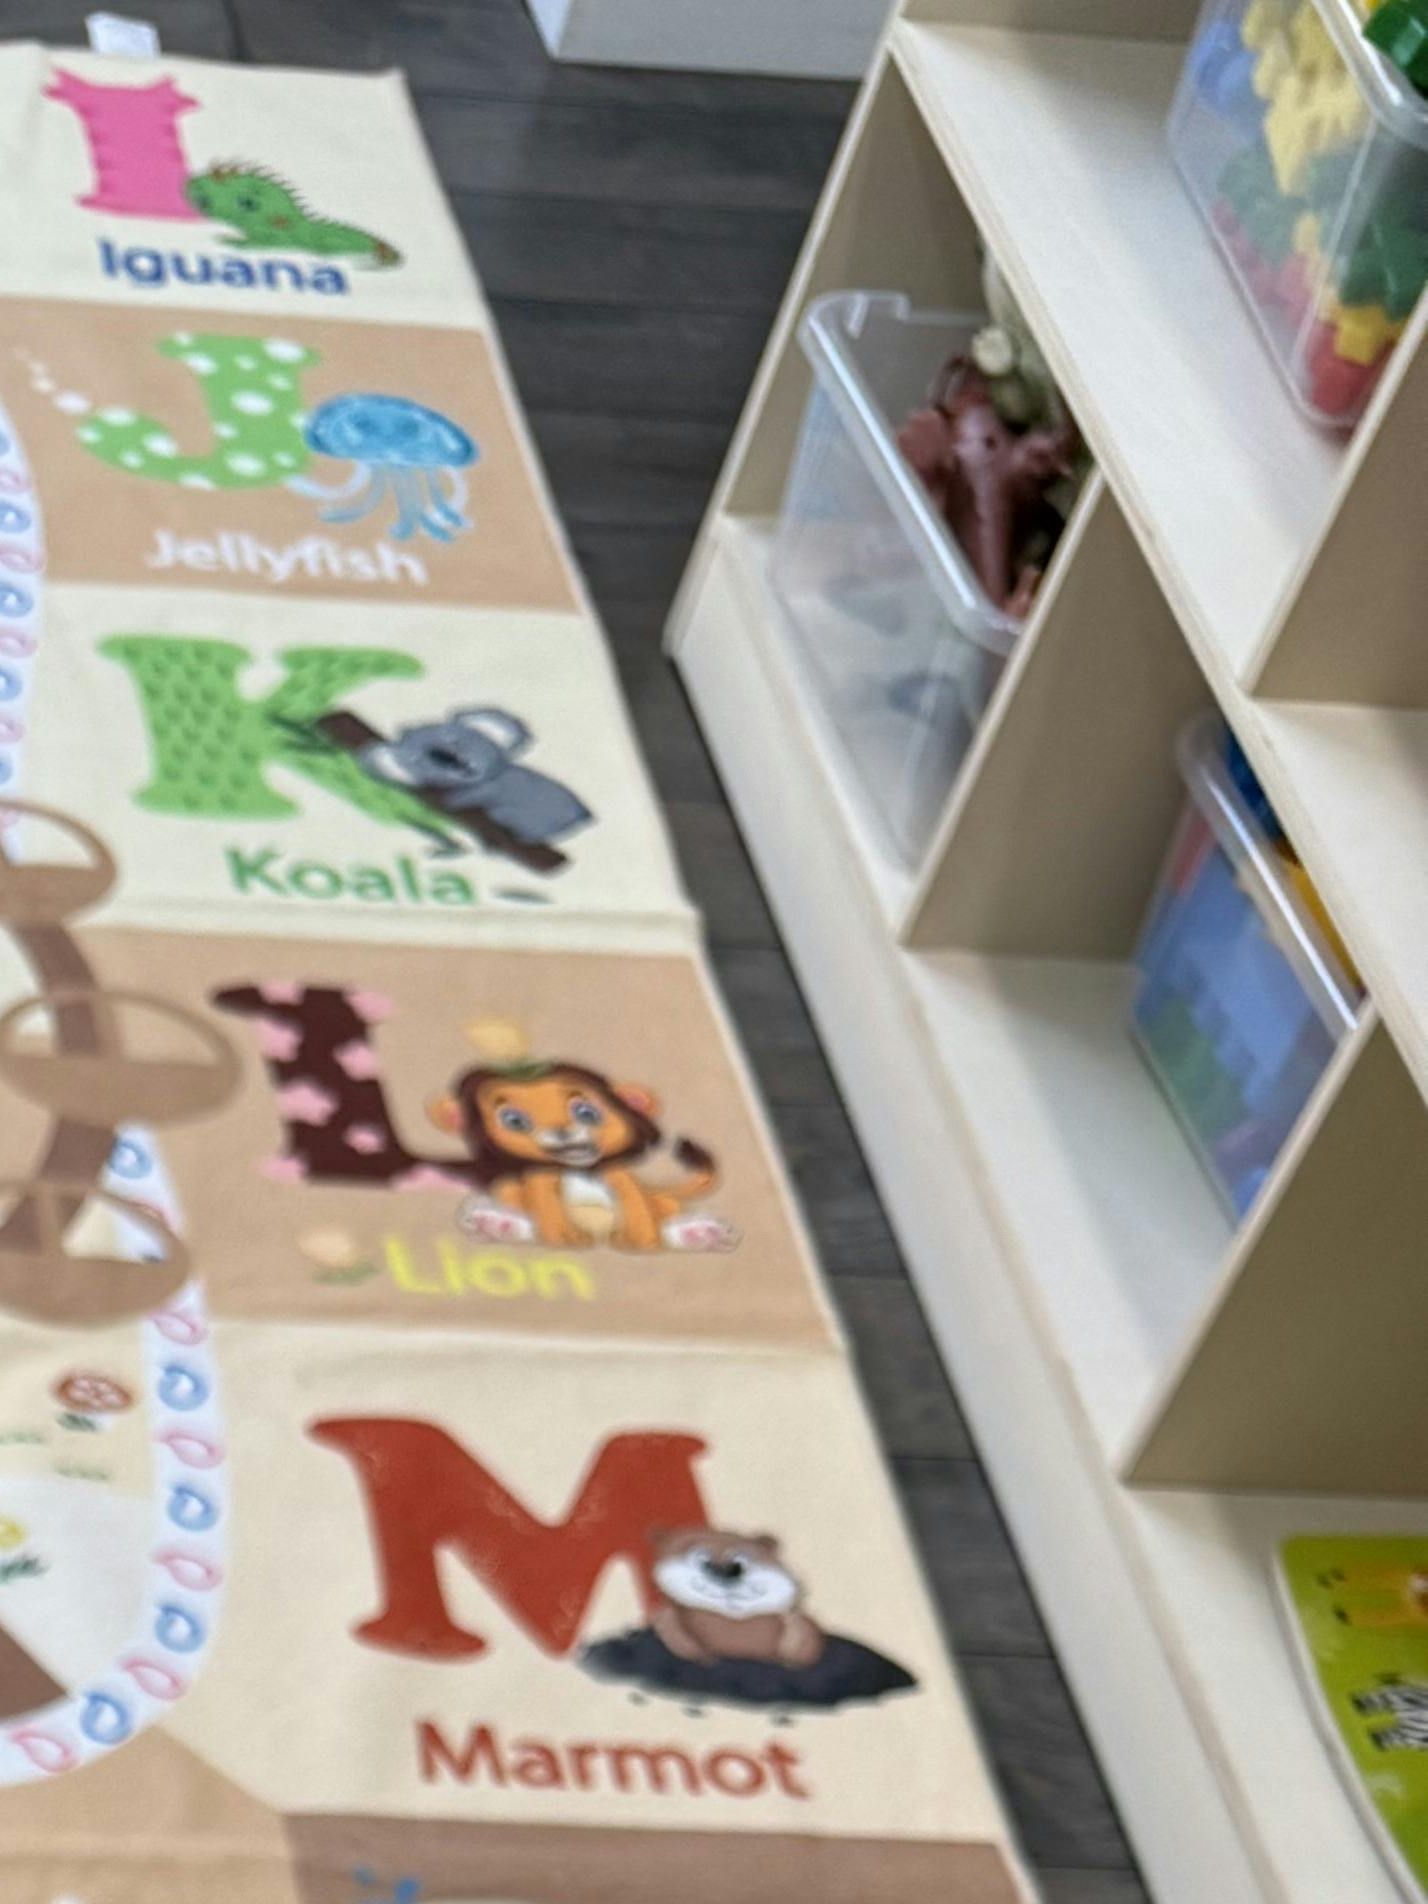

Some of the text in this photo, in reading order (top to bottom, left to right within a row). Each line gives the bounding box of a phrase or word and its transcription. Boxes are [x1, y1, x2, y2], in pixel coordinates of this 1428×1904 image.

[42, 67, 209, 223] I
[97, 236, 350, 295] Iguana
[78, 332, 324, 489] J
[147, 529, 429, 587] Jellyfish
[96, 633, 452, 845] K
[224, 845, 479, 904] Koala
[210, 981, 498, 1190] L
[382, 1234, 596, 1302] Lion
[307, 1415, 710, 1659] M
[415, 1717, 810, 1799] Marmot
